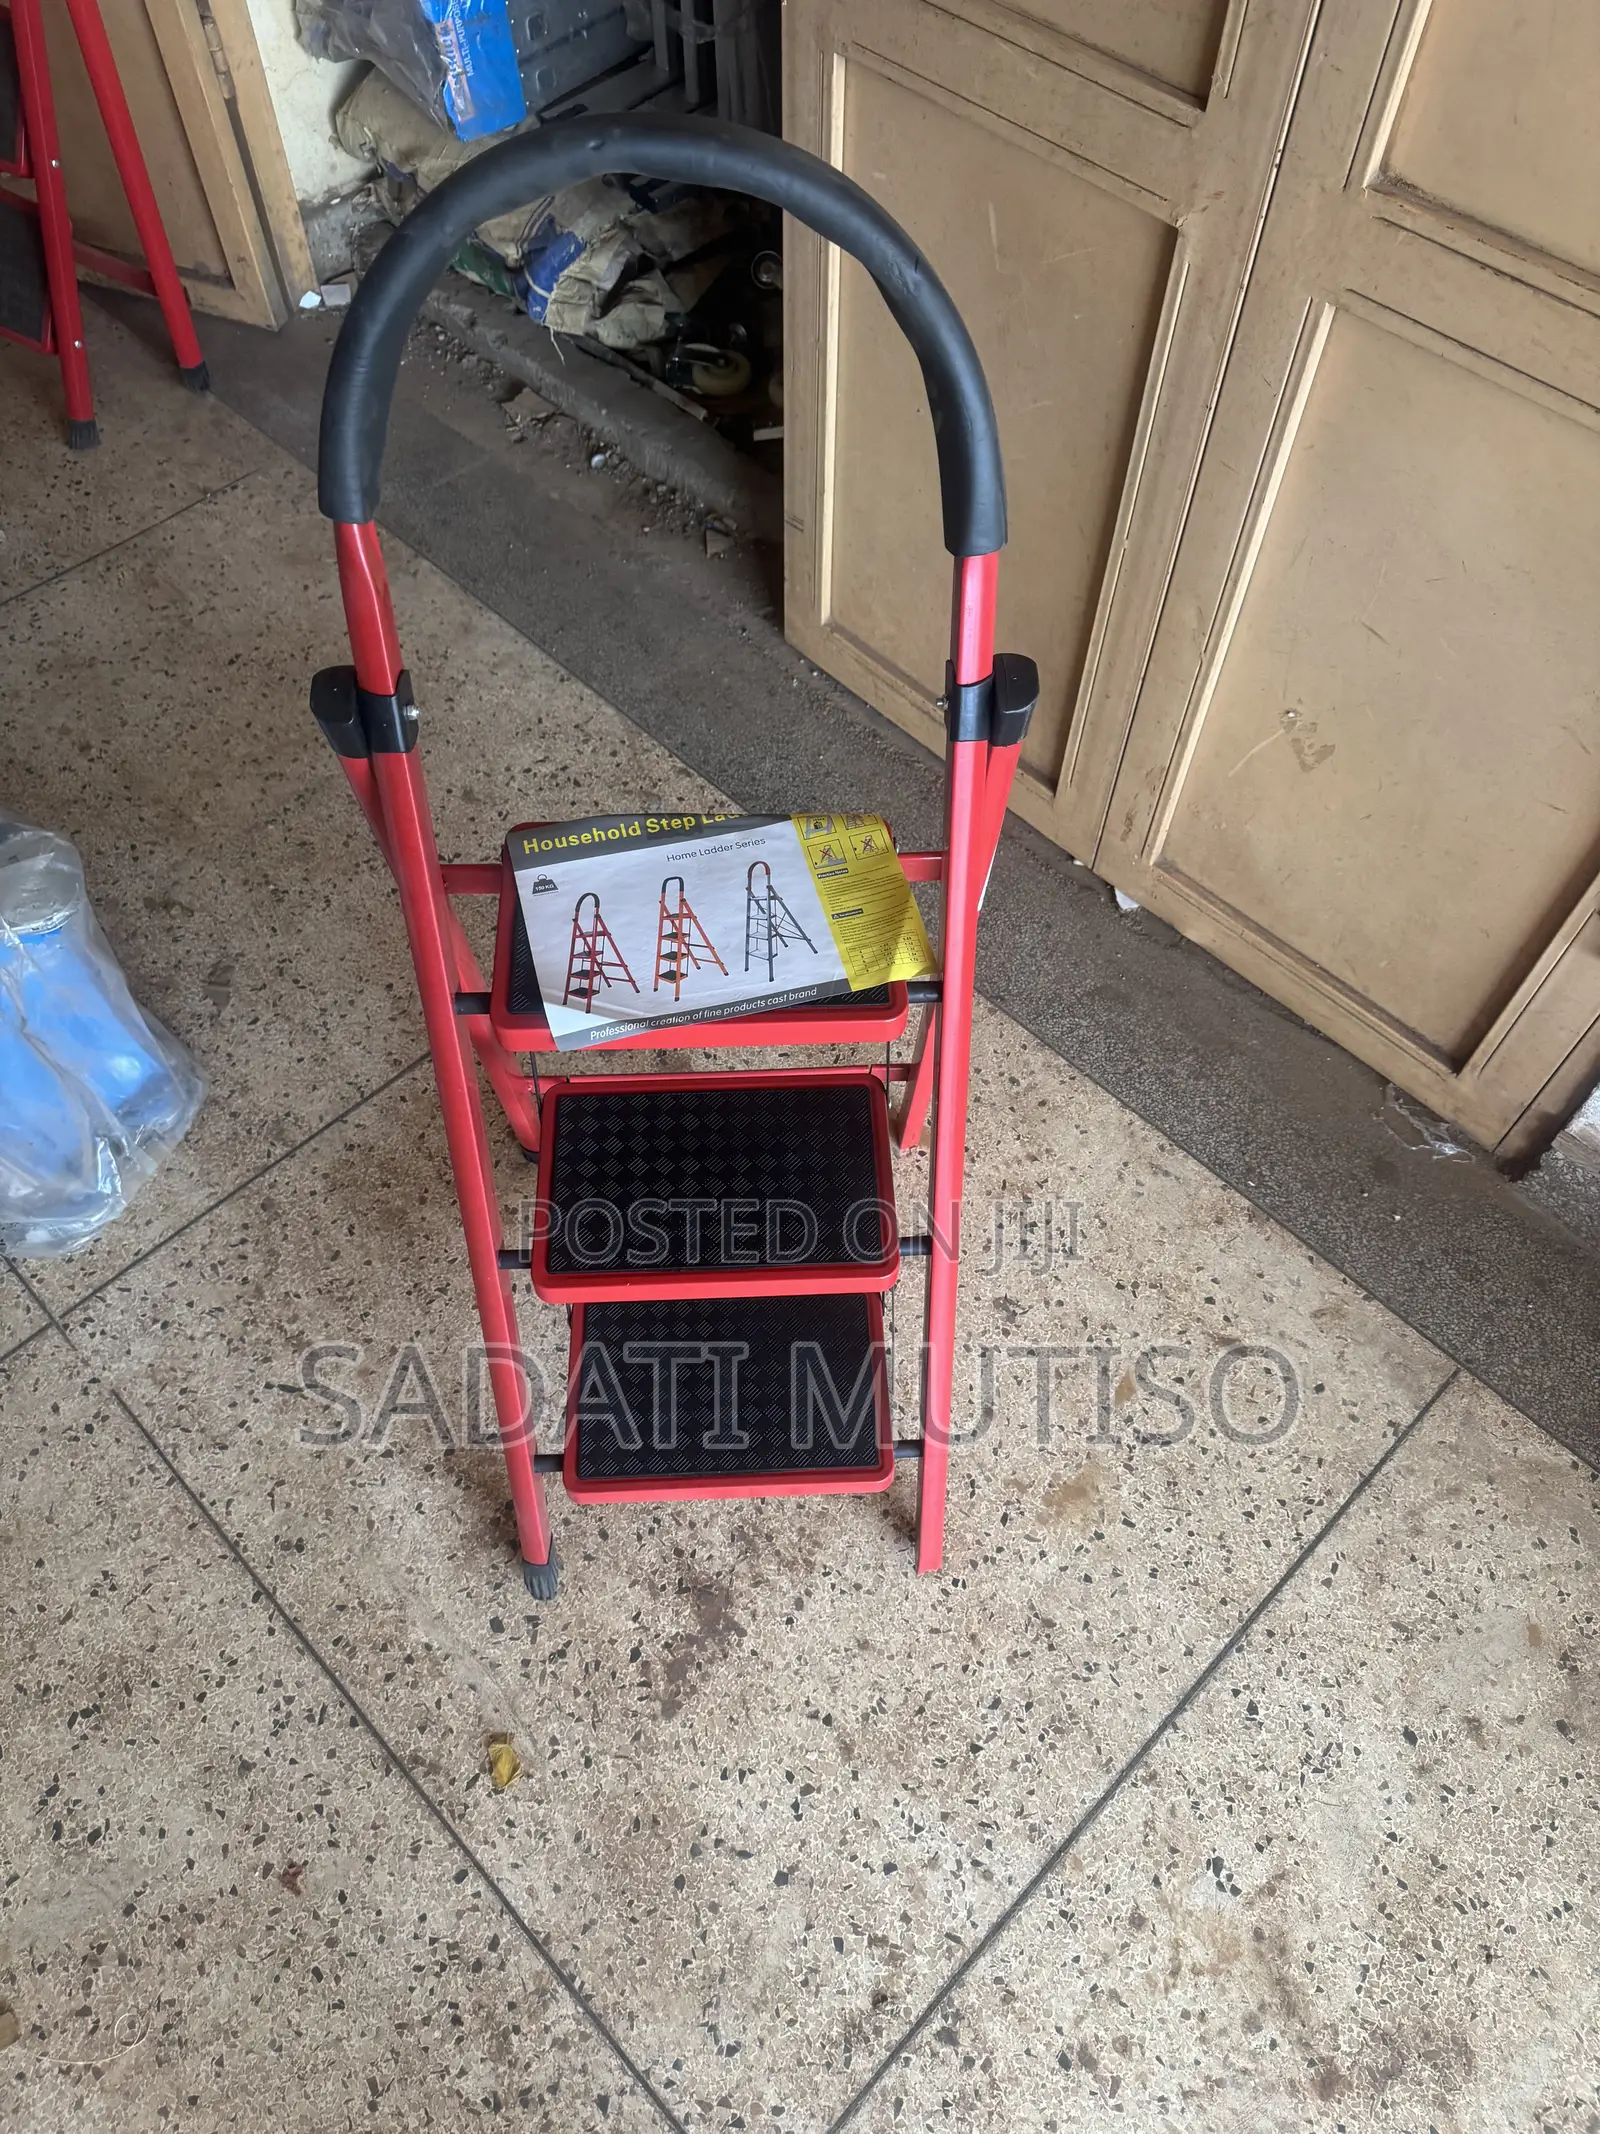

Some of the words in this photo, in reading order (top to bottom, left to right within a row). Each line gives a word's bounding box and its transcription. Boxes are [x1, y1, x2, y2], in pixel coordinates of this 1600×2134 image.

[523, 821, 642, 854] Household
[646, 815, 696, 833] Step
[666, 850, 697, 862] Home
[699, 844, 733, 857] Ladder
[735, 838, 766, 850] Series
[590, 1019, 649, 1041] Professional
[650, 1014, 691, 1027] creation
[692, 1010, 704, 1020] of
[704, 1007, 722, 1018] fine
[723, 999, 766, 1017] products
[767, 994, 787, 1006] cast
[788, 987, 818, 1001] brand
